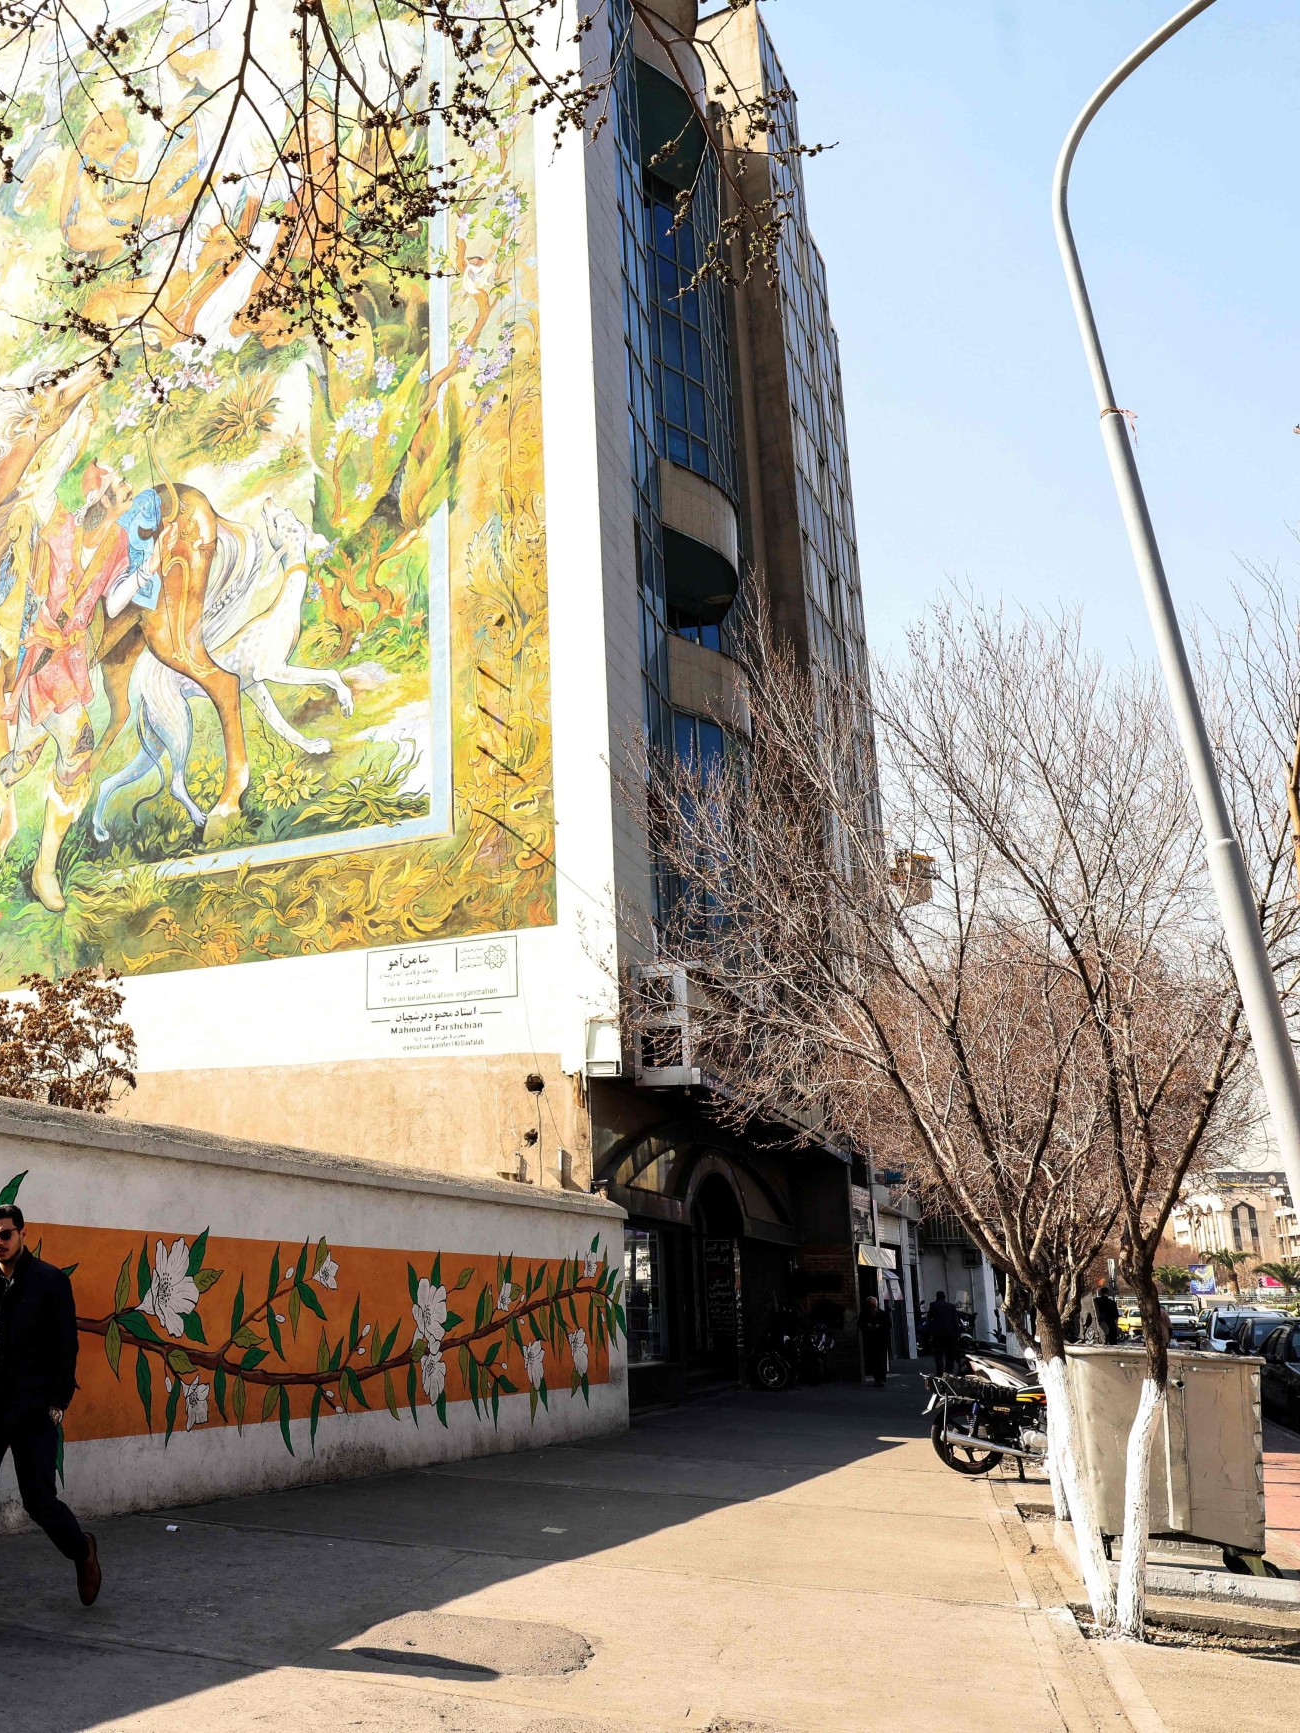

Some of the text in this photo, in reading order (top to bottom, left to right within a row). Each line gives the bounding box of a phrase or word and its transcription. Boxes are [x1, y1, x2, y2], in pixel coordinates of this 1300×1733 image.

[387, 953, 430, 971] ضامن آهو
[407, 991, 454, 1002] beautification
[456, 987, 498, 998] organization
[395, 1006, 477, 1024] استاد محمود فرشچیان
[390, 1021, 483, 1034] Mahmoud Farshchian
[402, 1043, 430, 1051] executive
